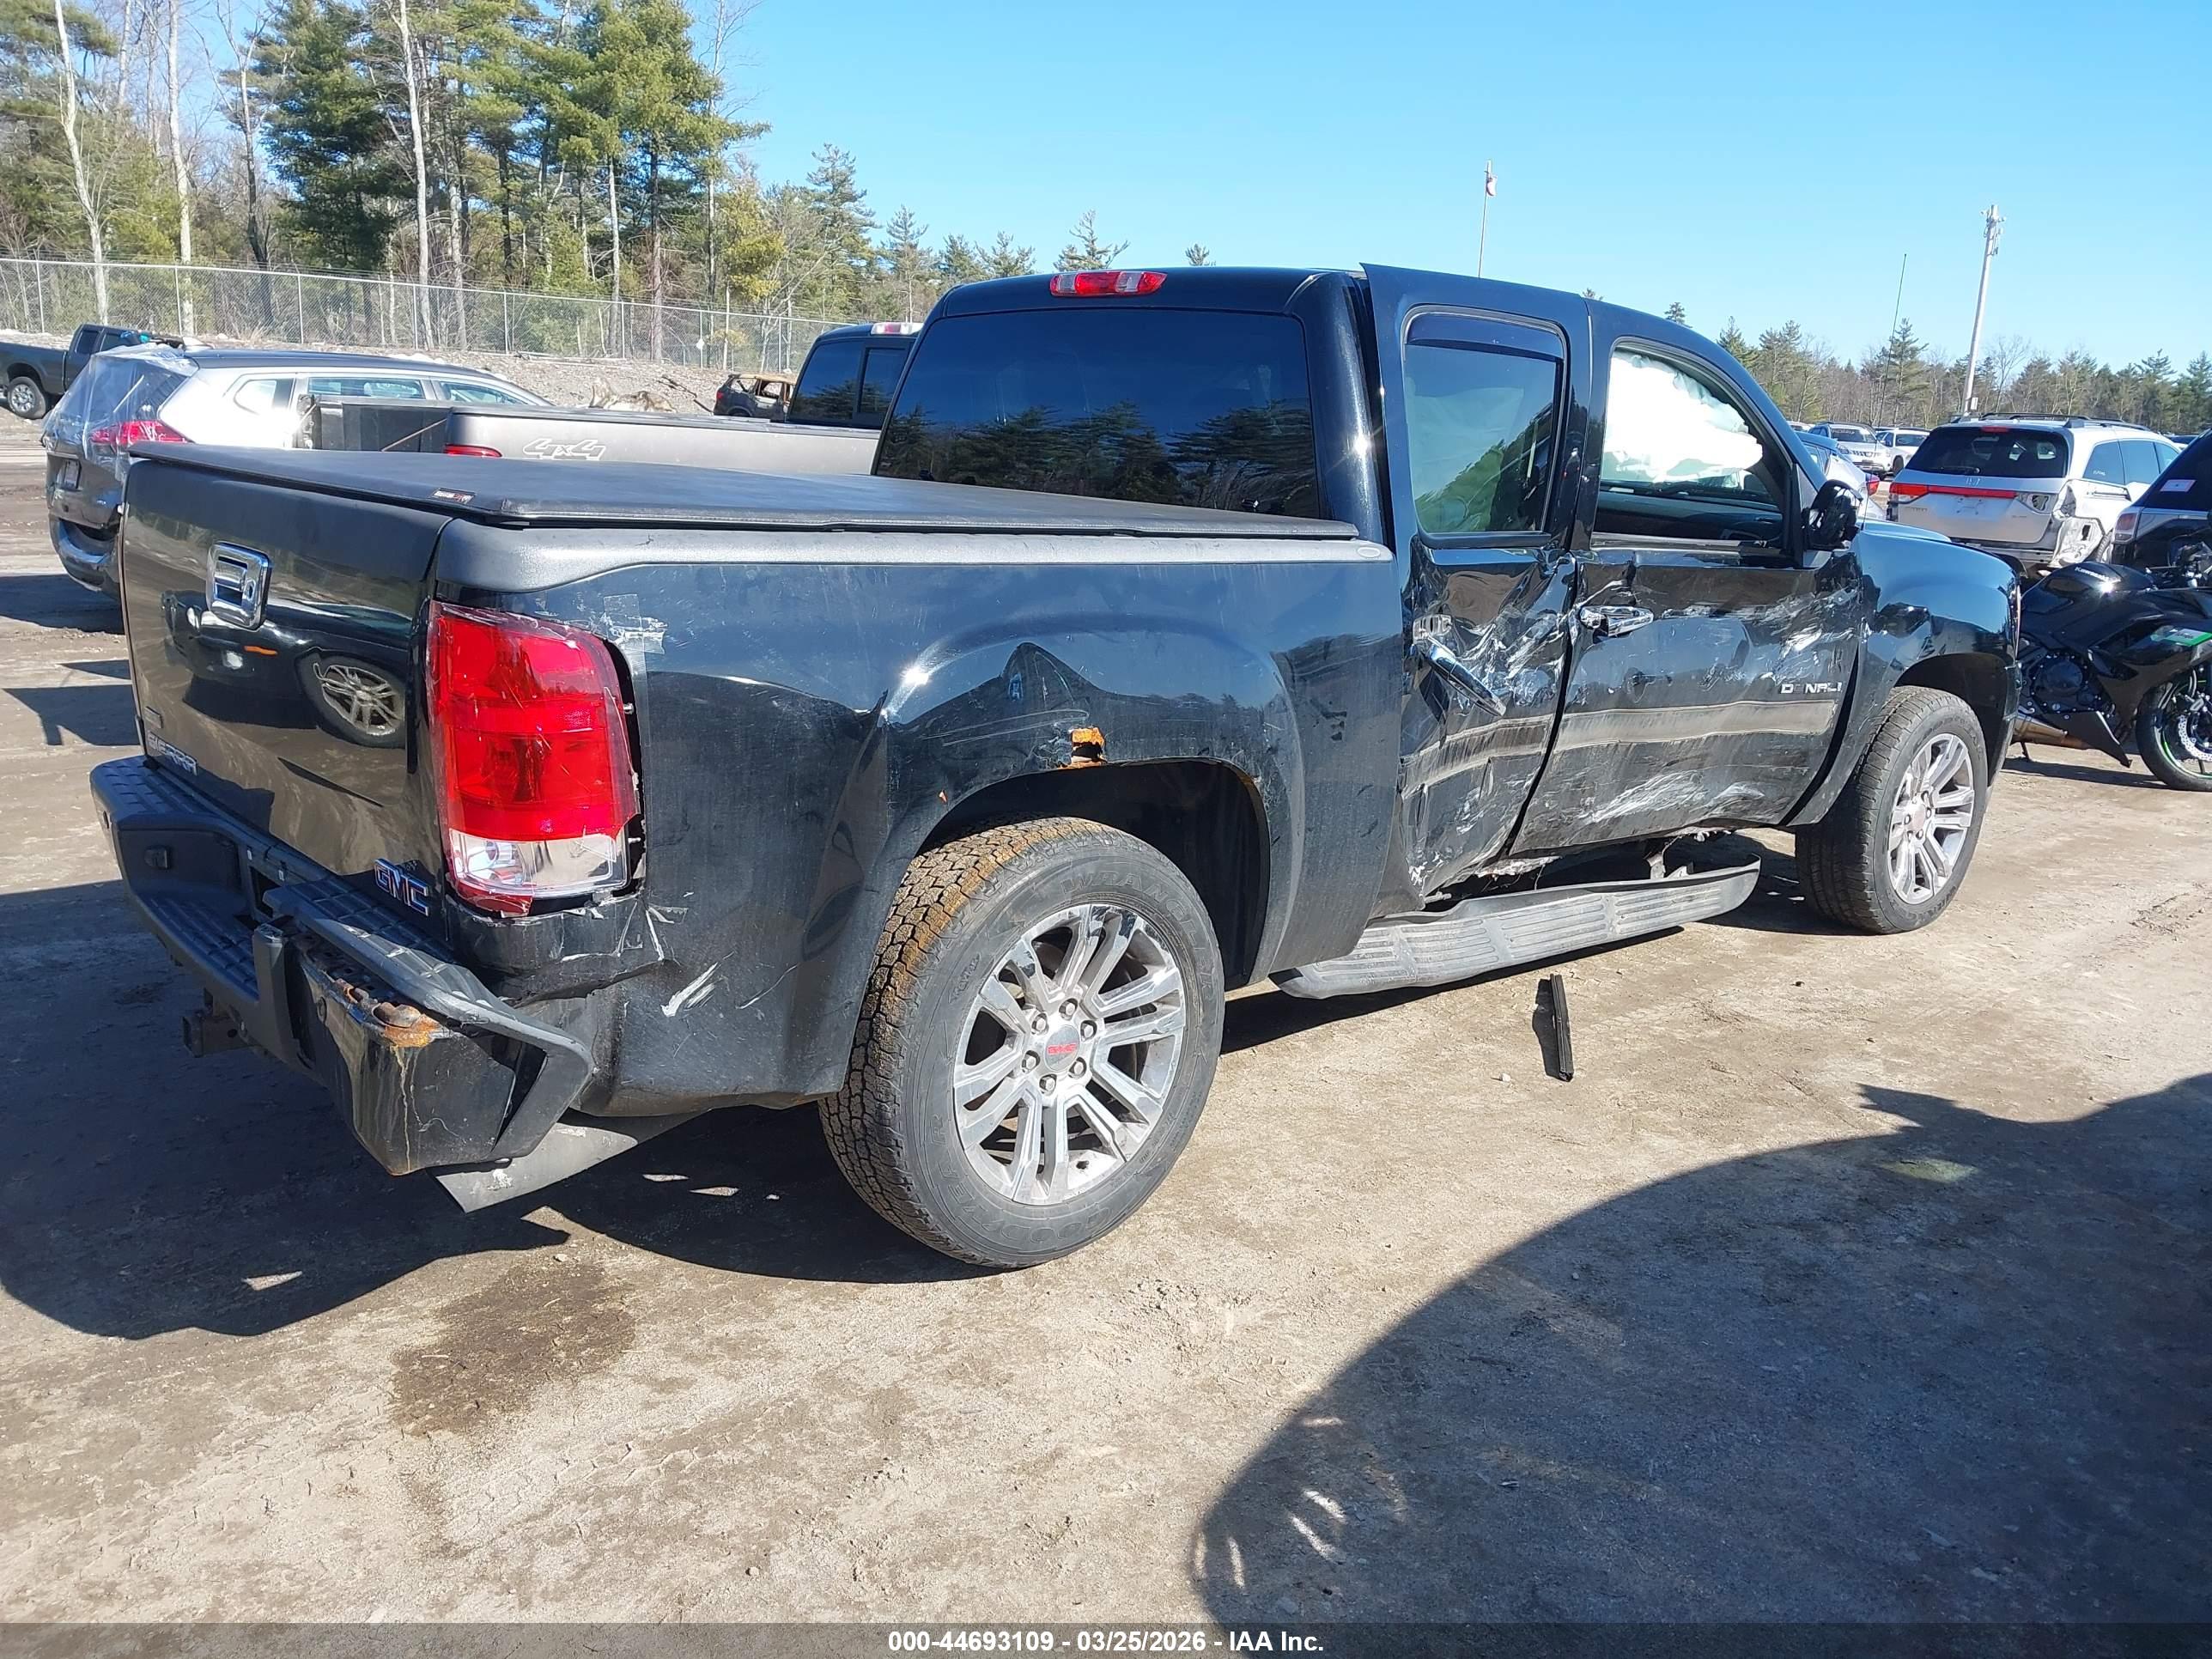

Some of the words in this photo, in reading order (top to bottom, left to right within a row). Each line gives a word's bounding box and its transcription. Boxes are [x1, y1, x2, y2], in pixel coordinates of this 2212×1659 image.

[522, 438, 606, 460] 4x4
[374, 858, 429, 917] GMC
[1059, 871, 1215, 989] WRANGLER
[1047, 1042, 1079, 1055] GMC
[927, 1112, 1112, 1244] GOODYEAR
